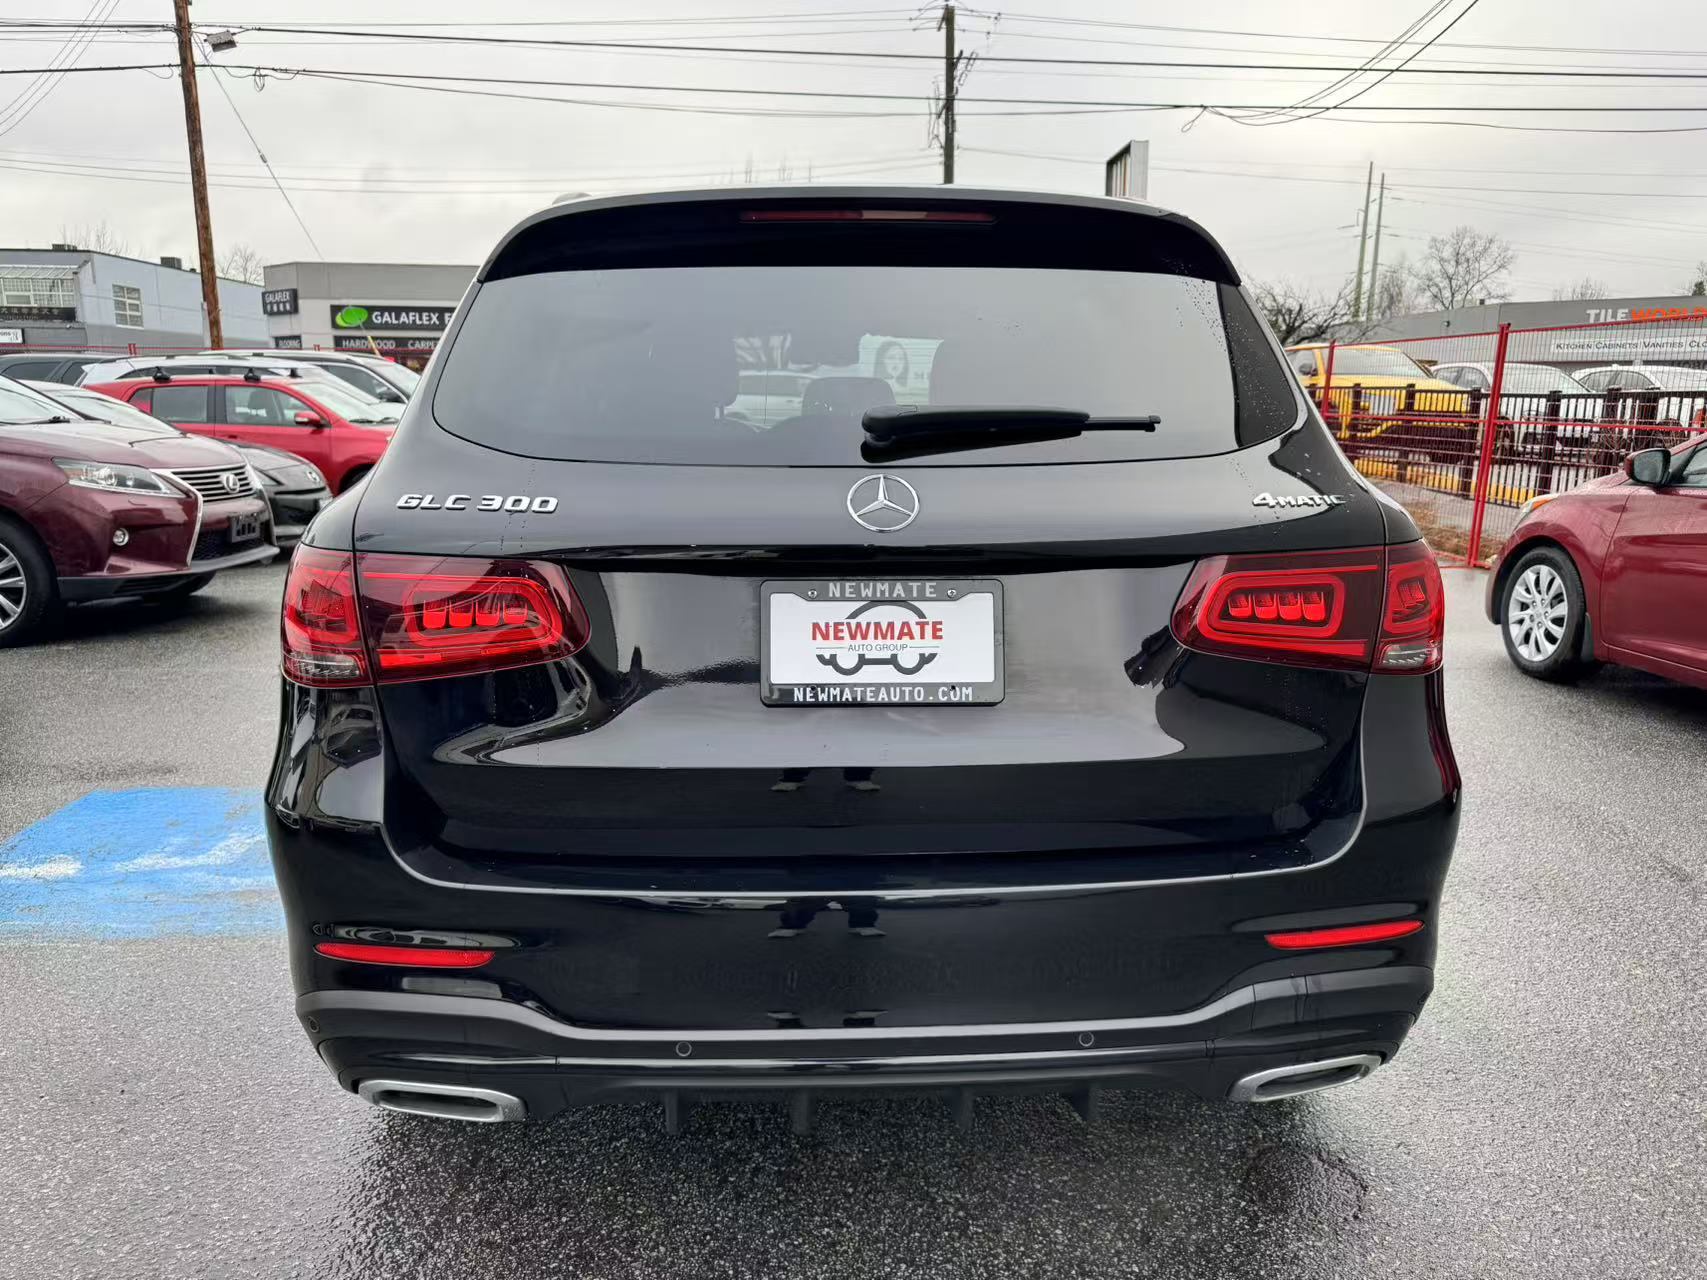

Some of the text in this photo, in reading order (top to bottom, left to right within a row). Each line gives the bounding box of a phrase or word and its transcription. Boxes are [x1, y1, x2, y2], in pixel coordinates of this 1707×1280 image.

[265, 291, 290, 303] GALAFLEX
[372, 311, 440, 325] GALAFLEX
[1595, 341, 1638, 350] CABINETS
[1642, 340, 1684, 349] VANITIES
[396, 494, 559, 514] GLC 300
[1252, 492, 1347, 508] 4MATIC
[828, 582, 938, 598] NEWMATE
[811, 620, 944, 641] NEWMATE
[847, 643, 909, 652] AUTO GROUP
[793, 686, 973, 702] NEWMATEAUTO.COM
